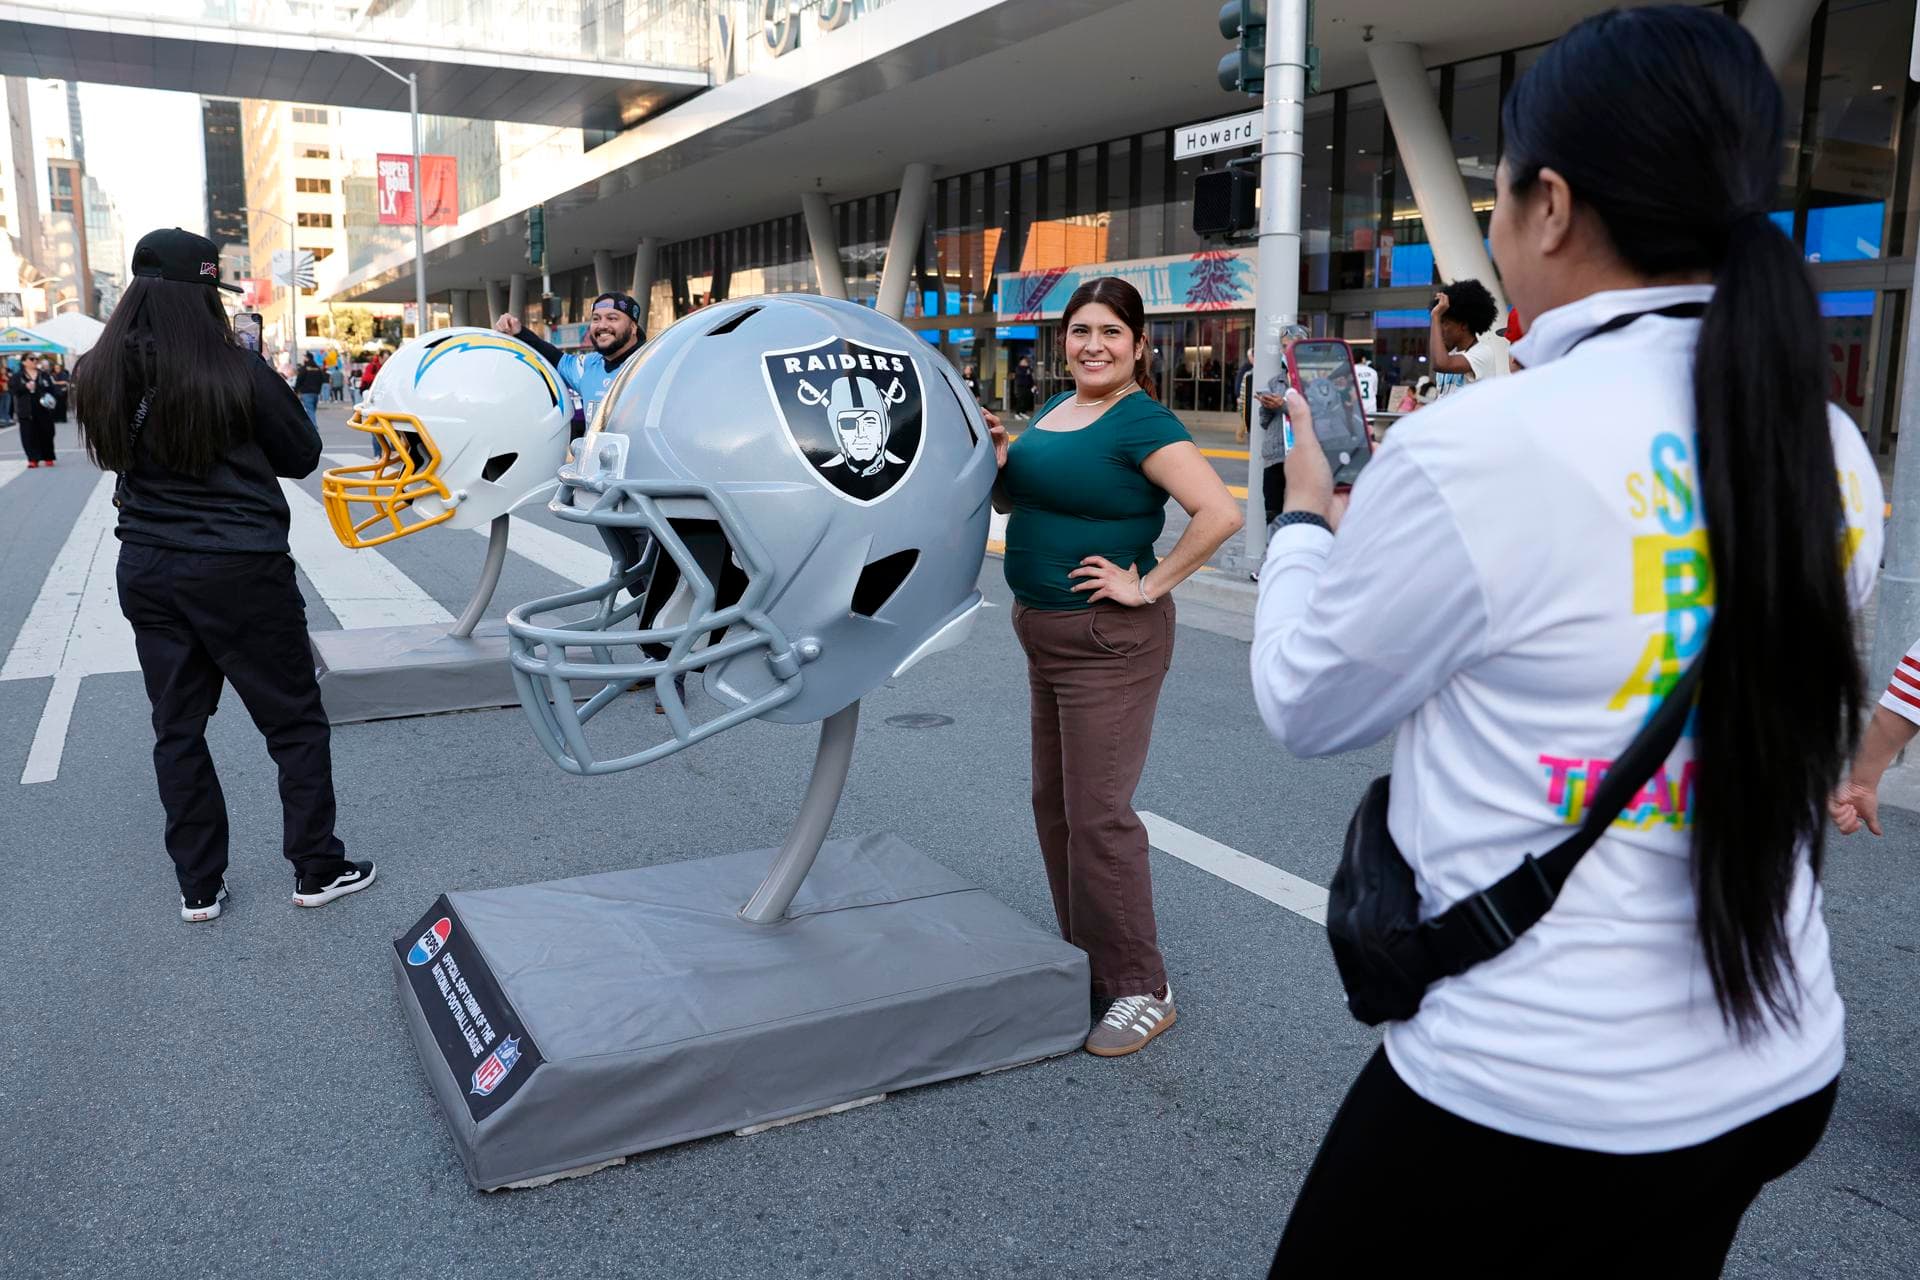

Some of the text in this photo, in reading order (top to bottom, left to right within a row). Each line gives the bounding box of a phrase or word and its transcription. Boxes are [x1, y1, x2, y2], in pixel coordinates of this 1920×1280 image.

[1187, 121, 1250, 150] Howard
[379, 160, 410, 177] SUPER
[385, 174, 412, 192] BOWL
[380, 189, 397, 215] LX
[783, 354, 905, 374] RAIDERS
[423, 930, 440, 956] PEPSI
[431, 962, 485, 1059] NATIONAL FOOTBALL LEAGUE
[442, 952, 496, 1046] OFFICIAL SOFT DRINK OF THE
[477, 1055, 504, 1091] NFL
